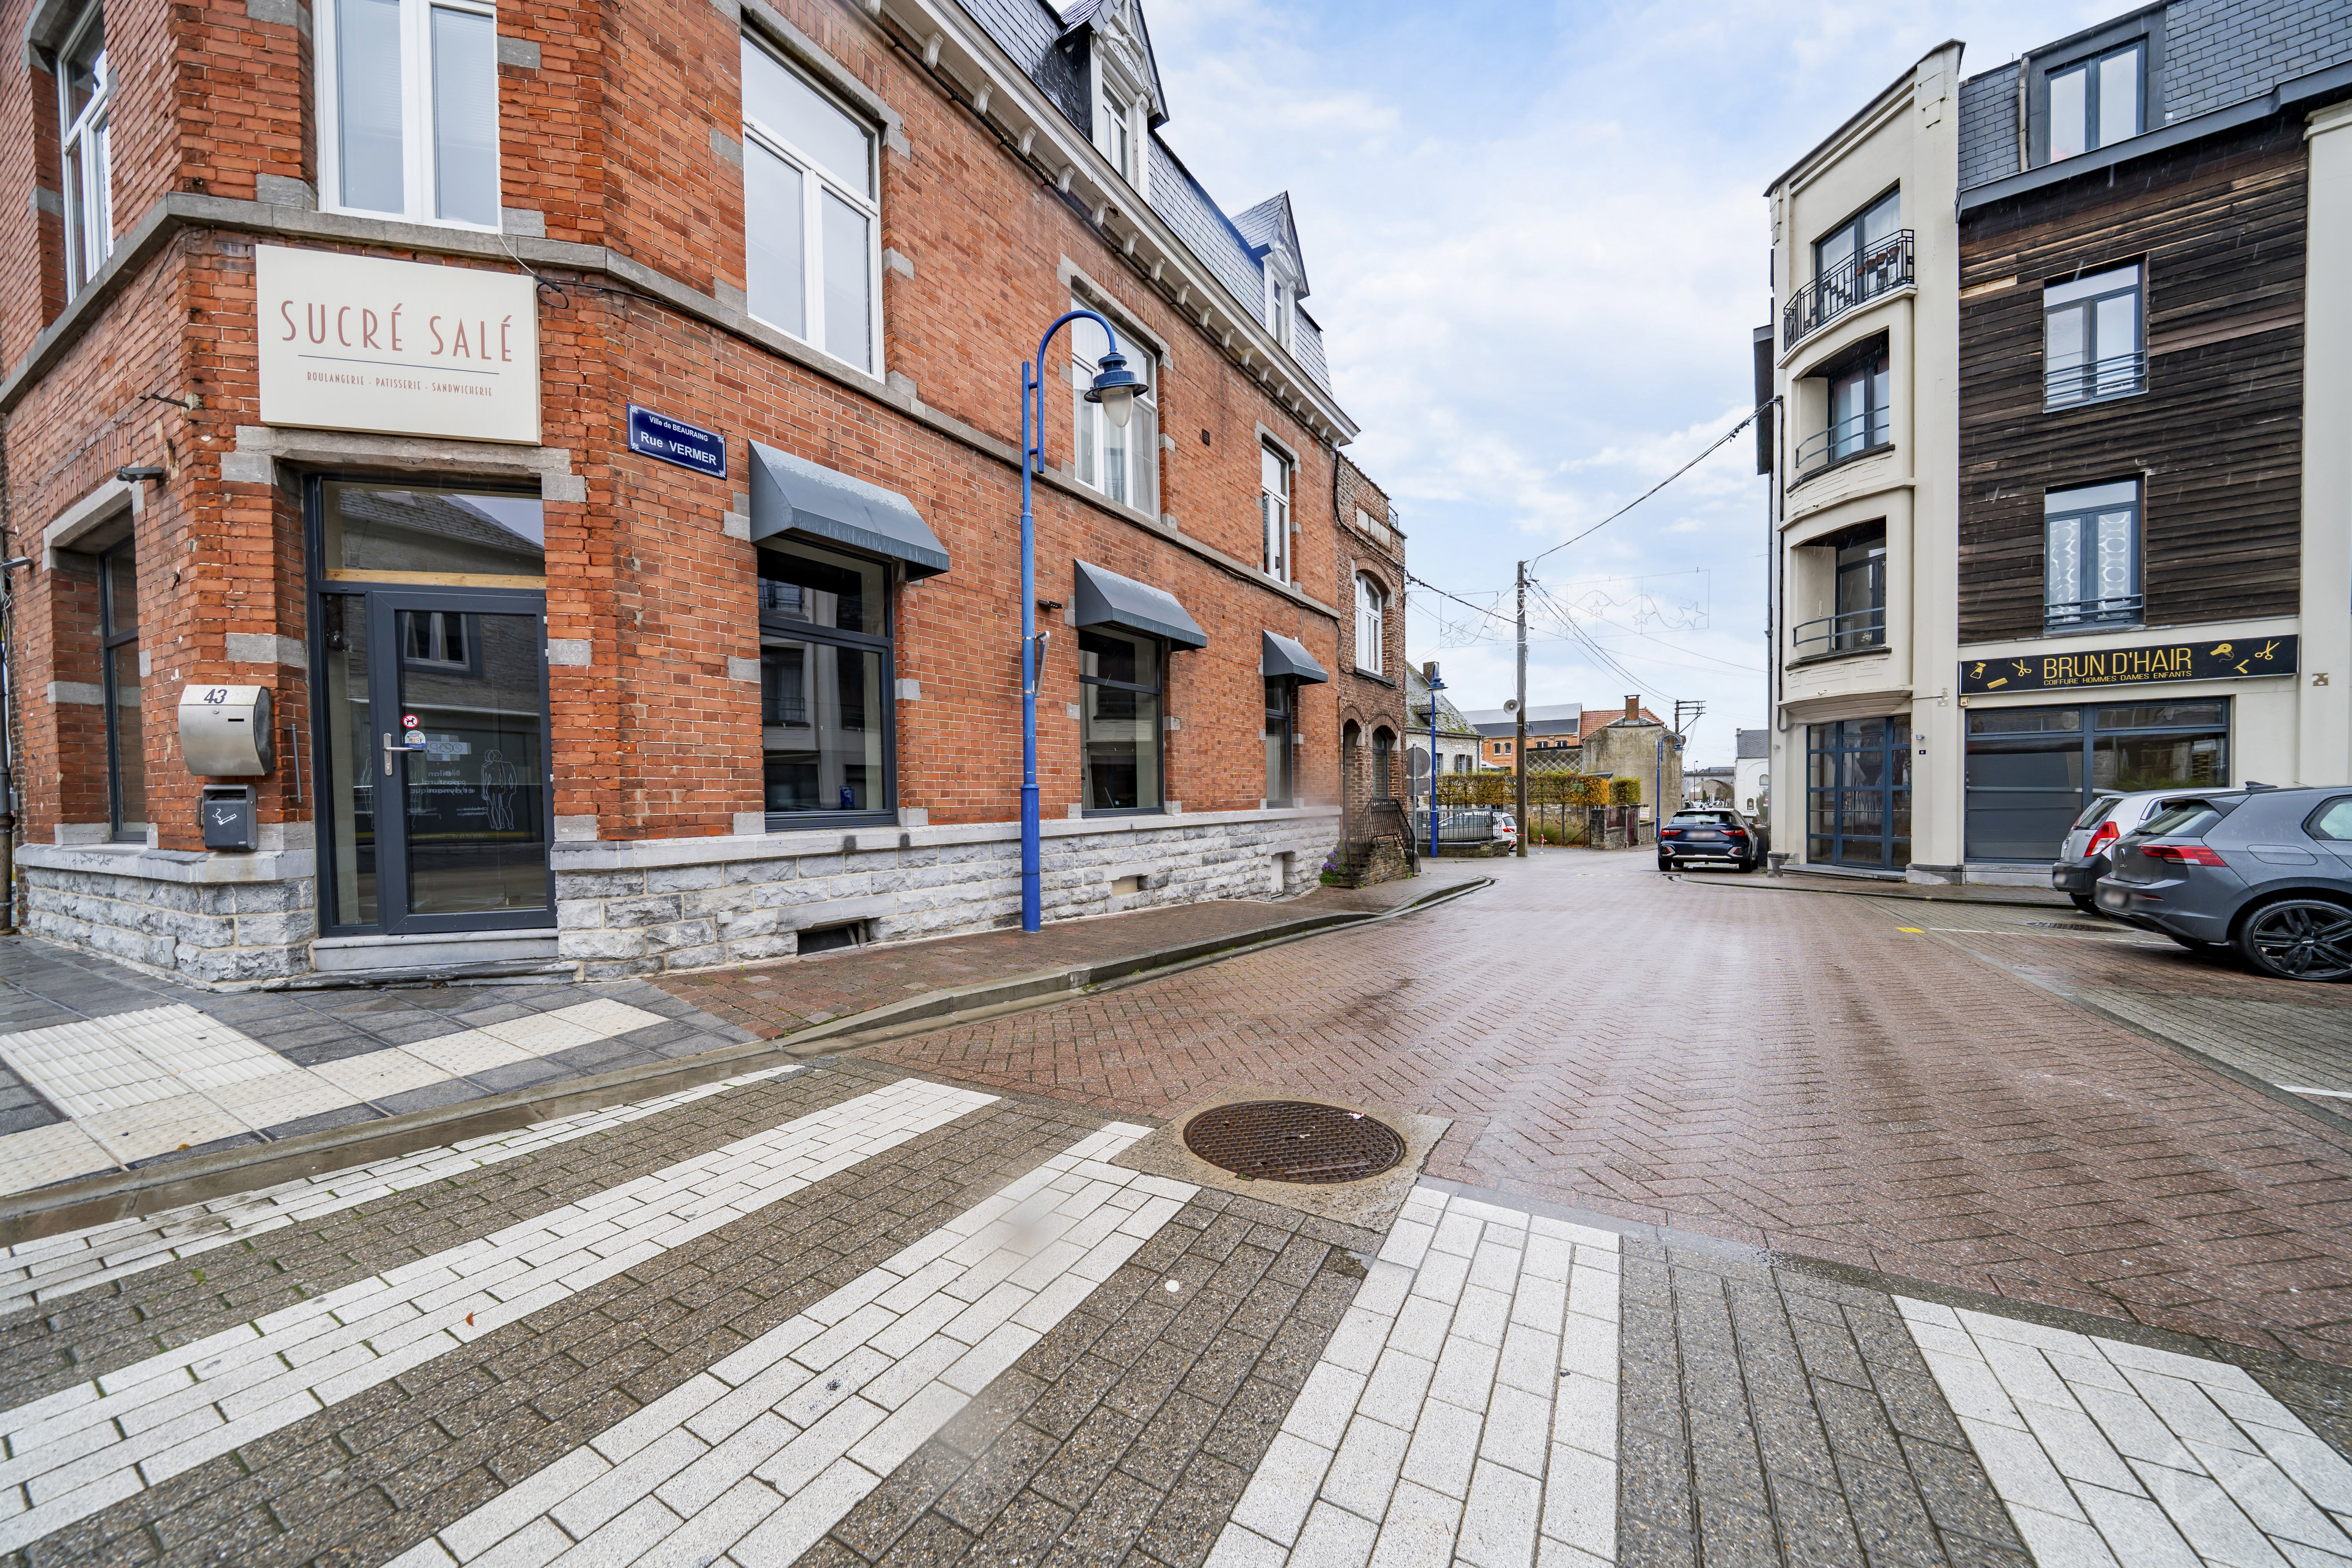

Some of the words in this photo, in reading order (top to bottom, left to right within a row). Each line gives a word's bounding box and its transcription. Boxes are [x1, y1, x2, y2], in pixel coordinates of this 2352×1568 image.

[281, 300, 403, 351] SUCRÉ
[429, 315, 512, 362] SALÉ
[307, 371, 364, 385] BOULANGERIE
[376, 377, 421, 390] PATISSERIE
[432, 383, 492, 396] SANDWICHERIE
[649, 415, 662, 426] Ville
[673, 424, 708, 442] BEAURAING
[641, 431, 663, 448] Rue
[669, 440, 717, 465] VERMER
[2043, 654, 2104, 679] BRUN
[2113, 648, 2192, 674] D'HAIR
[2153, 670, 2192, 679] ENFANTS
[204, 689, 227, 704] 43
